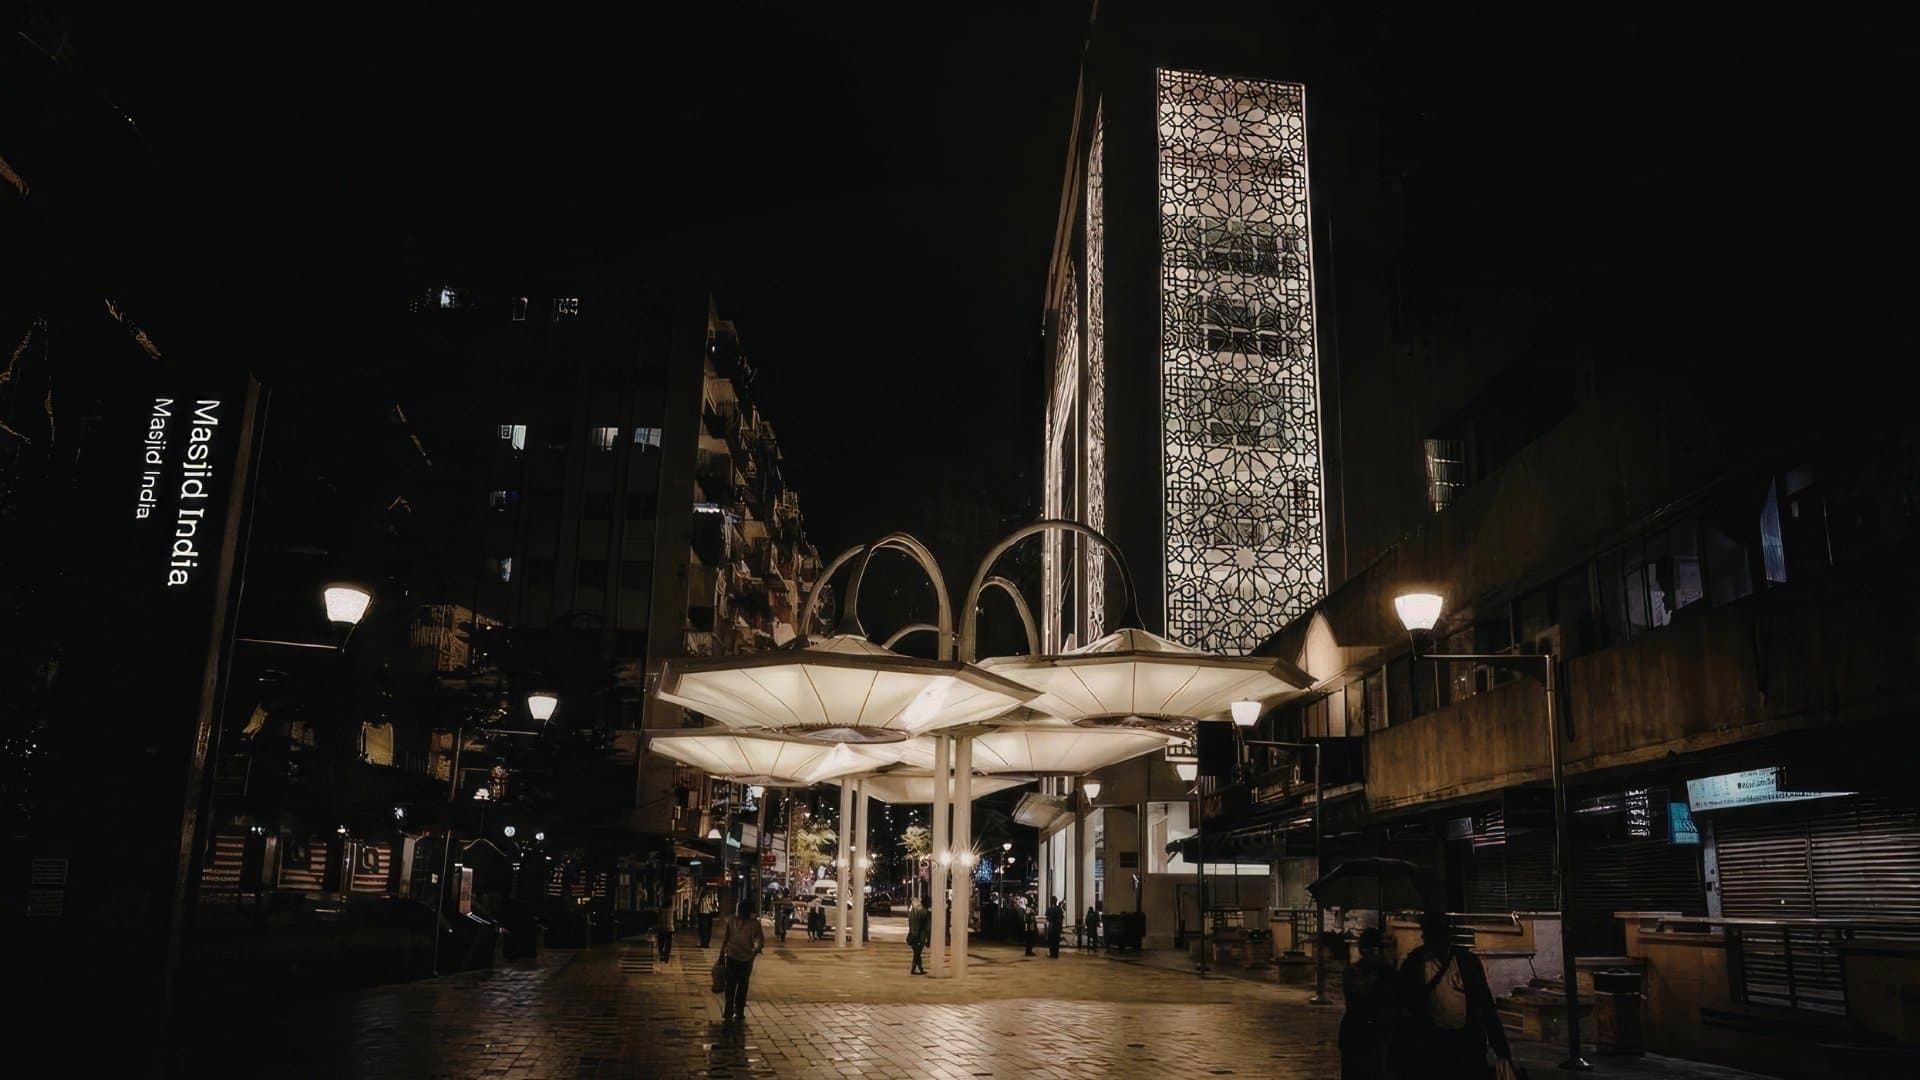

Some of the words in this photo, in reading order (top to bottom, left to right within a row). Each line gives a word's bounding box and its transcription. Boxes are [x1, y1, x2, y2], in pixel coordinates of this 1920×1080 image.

[144, 398, 174, 465] Masjid
[179, 399, 221, 500] Masjid
[136, 471, 161, 520] India
[167, 508, 205, 587] India
